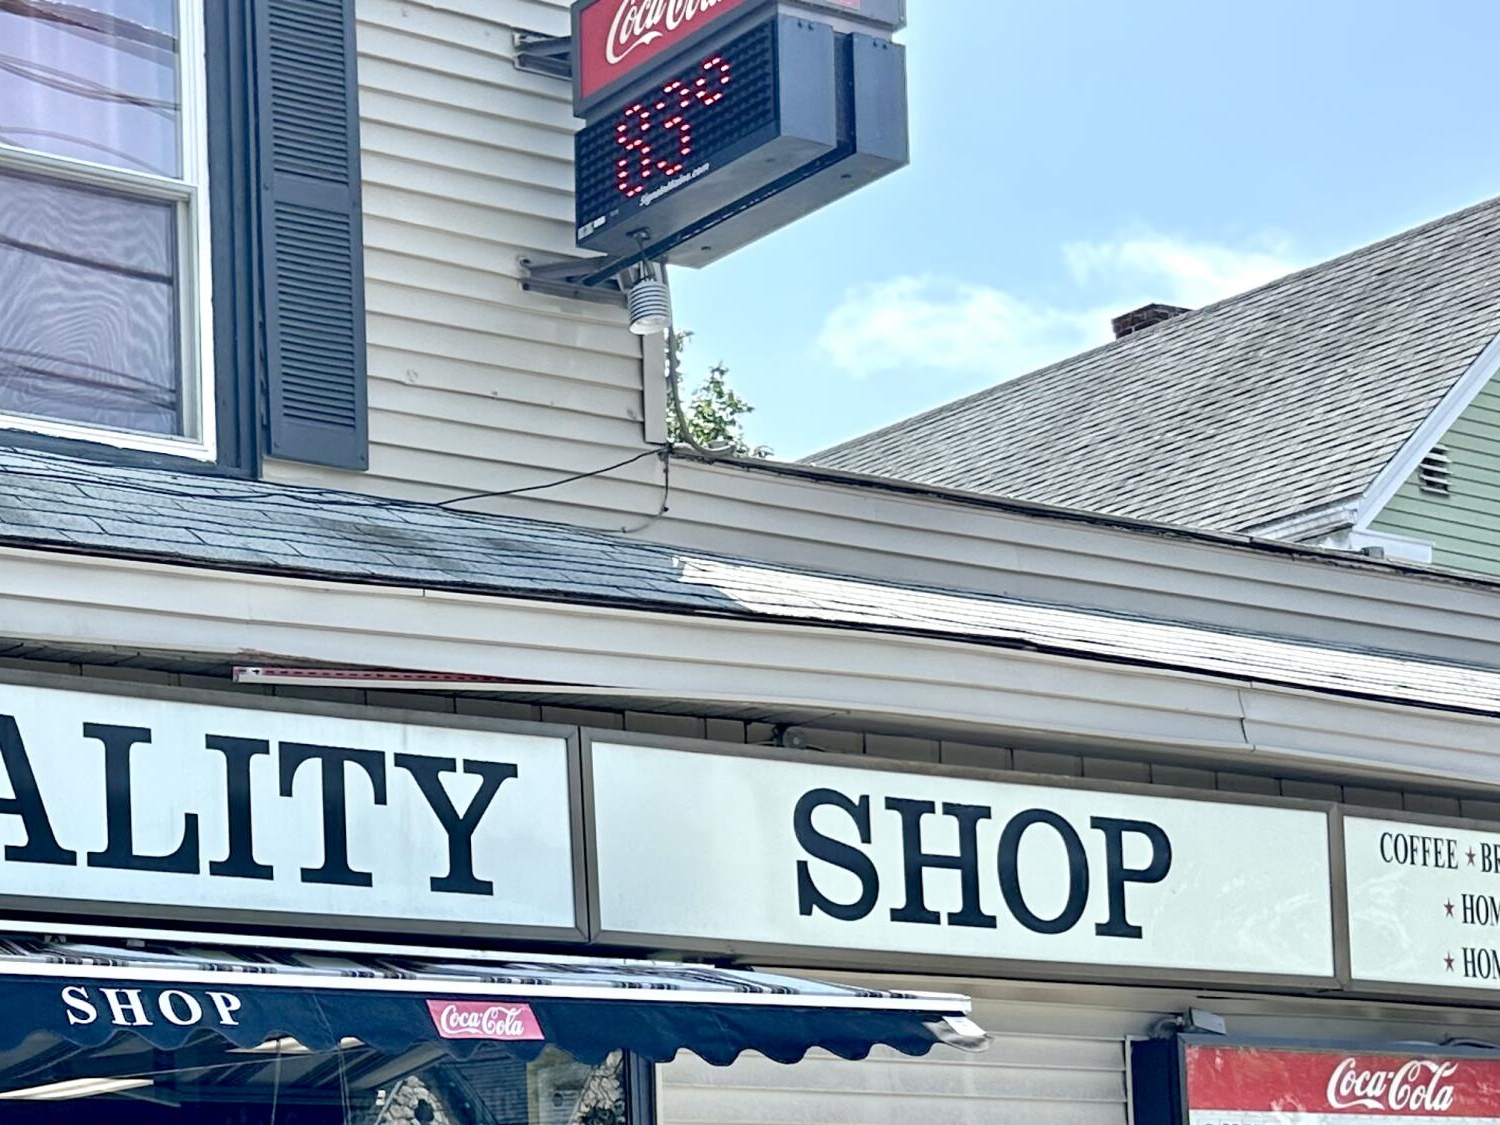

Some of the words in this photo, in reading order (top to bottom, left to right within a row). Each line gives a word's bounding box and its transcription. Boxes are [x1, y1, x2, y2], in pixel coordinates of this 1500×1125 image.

[793, 787, 1173, 940] SHOP
[1379, 831, 1459, 870] COFFEE
[61, 986, 242, 1026] SHOP
[441, 1004, 527, 1036] Coca-Cola
[1326, 1057, 1458, 1112] Coca-Cola
